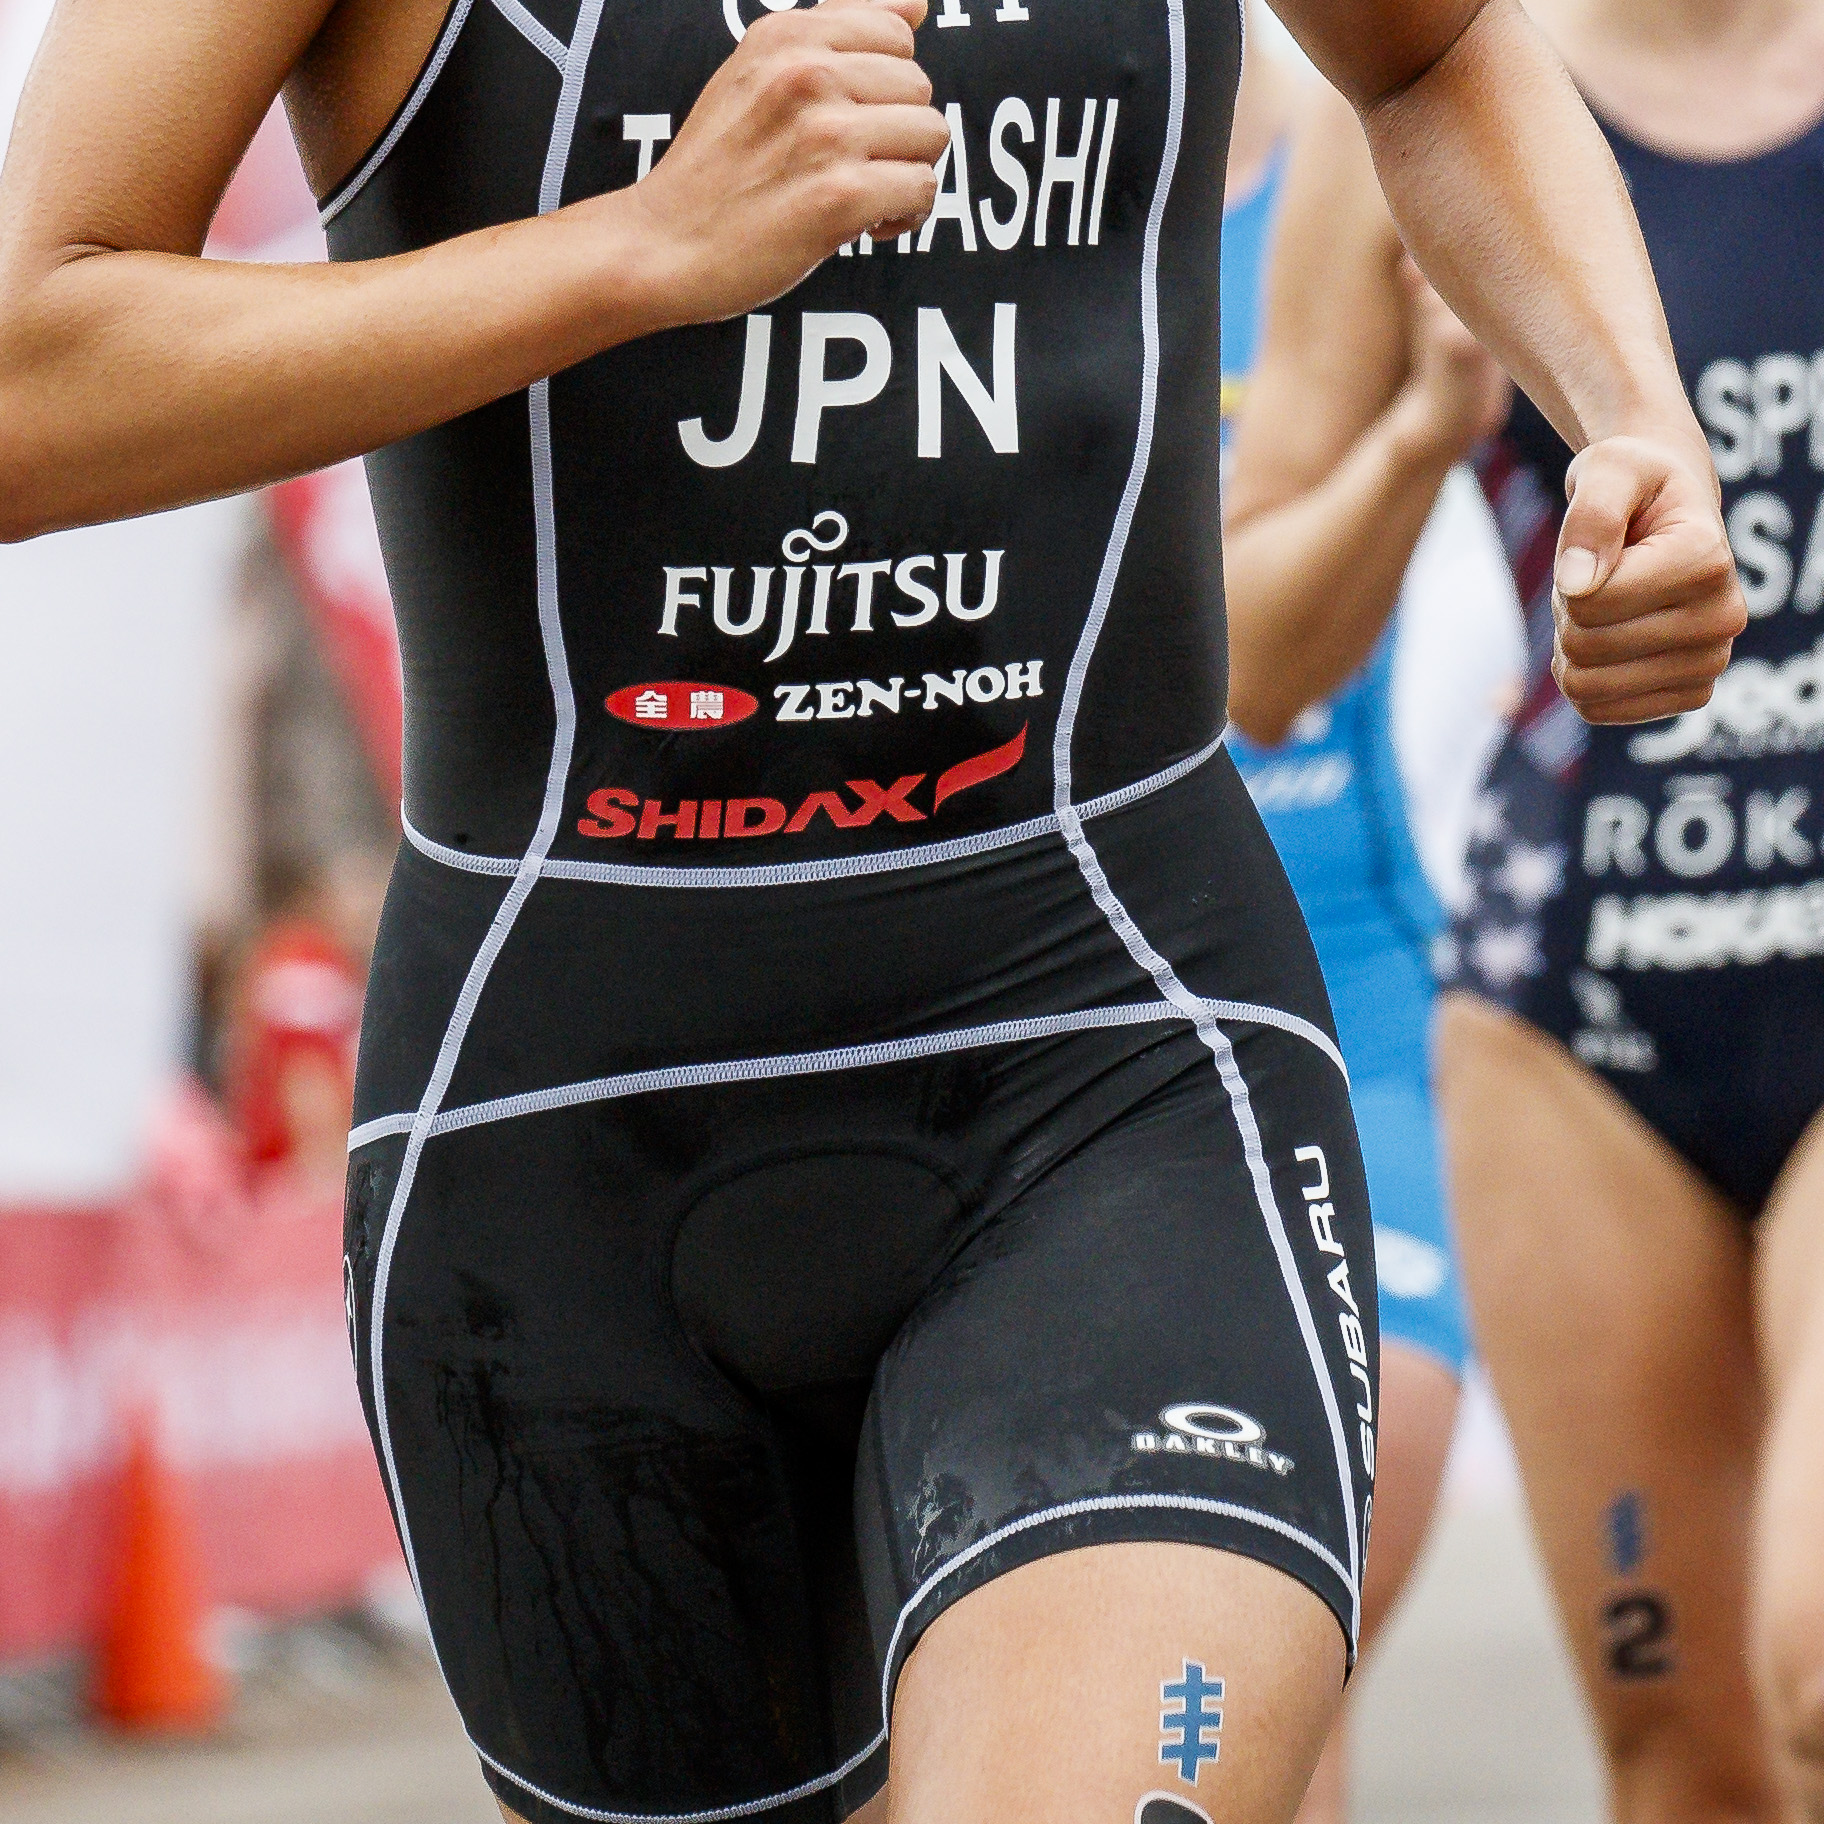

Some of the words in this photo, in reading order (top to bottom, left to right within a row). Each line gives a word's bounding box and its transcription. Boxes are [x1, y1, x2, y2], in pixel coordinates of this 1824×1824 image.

[678, 302, 1019, 468] JPN
[657, 536, 1005, 663] FUJITSU
[634, 690, 725, 721] 全農
[774, 660, 1043, 722] ZEN-NOH
[577, 773, 928, 839] SHIDAX
[1294, 1144, 1377, 1481] SUBARU
[1134, 1431, 1288, 1474] OAKLEY
[1602, 1589, 1673, 1681] 2
